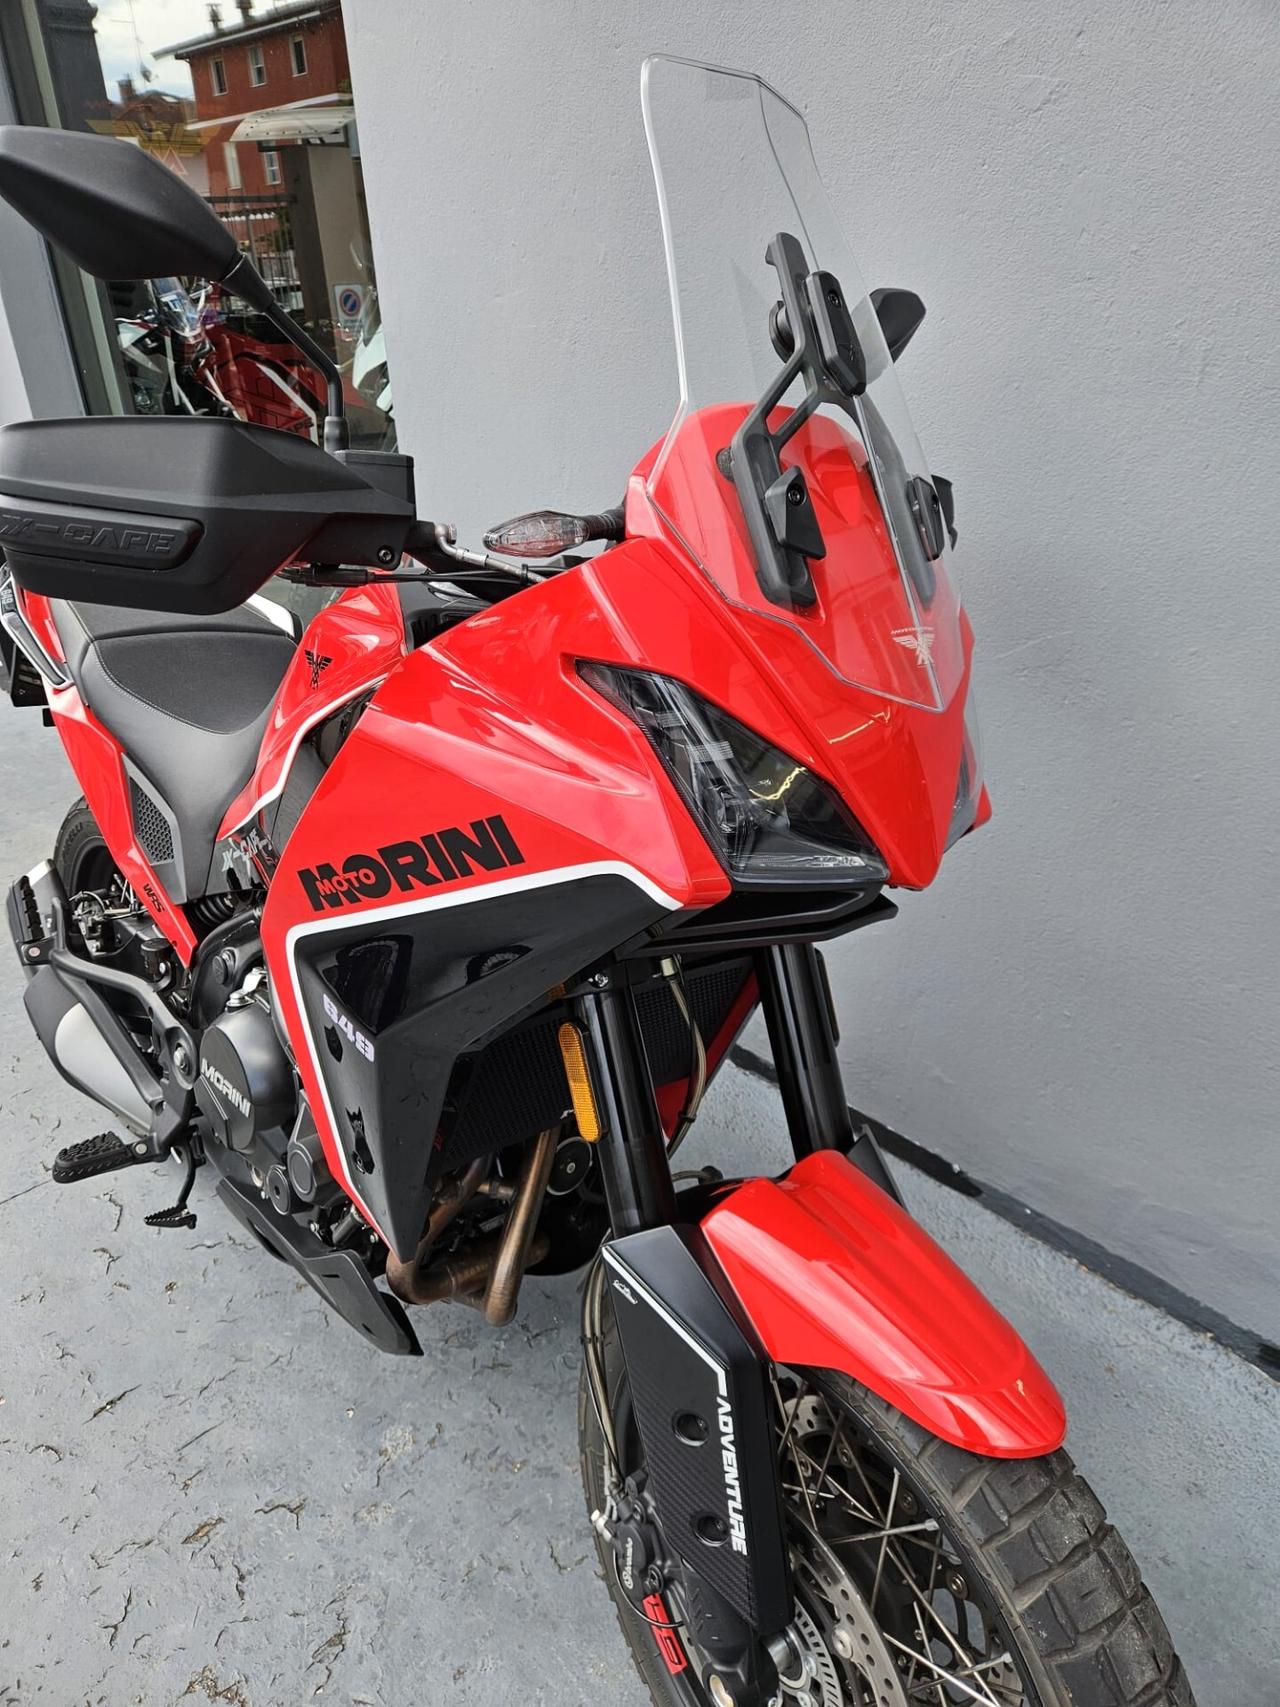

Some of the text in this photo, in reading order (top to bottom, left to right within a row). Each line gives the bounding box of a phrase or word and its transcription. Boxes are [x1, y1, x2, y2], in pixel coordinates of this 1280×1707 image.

[297, 814, 526, 912] MORINI
[315, 868, 376, 896] MOTO
[201, 1058, 251, 1118] MORINI
[716, 1396, 748, 1556] ADVENTURE
